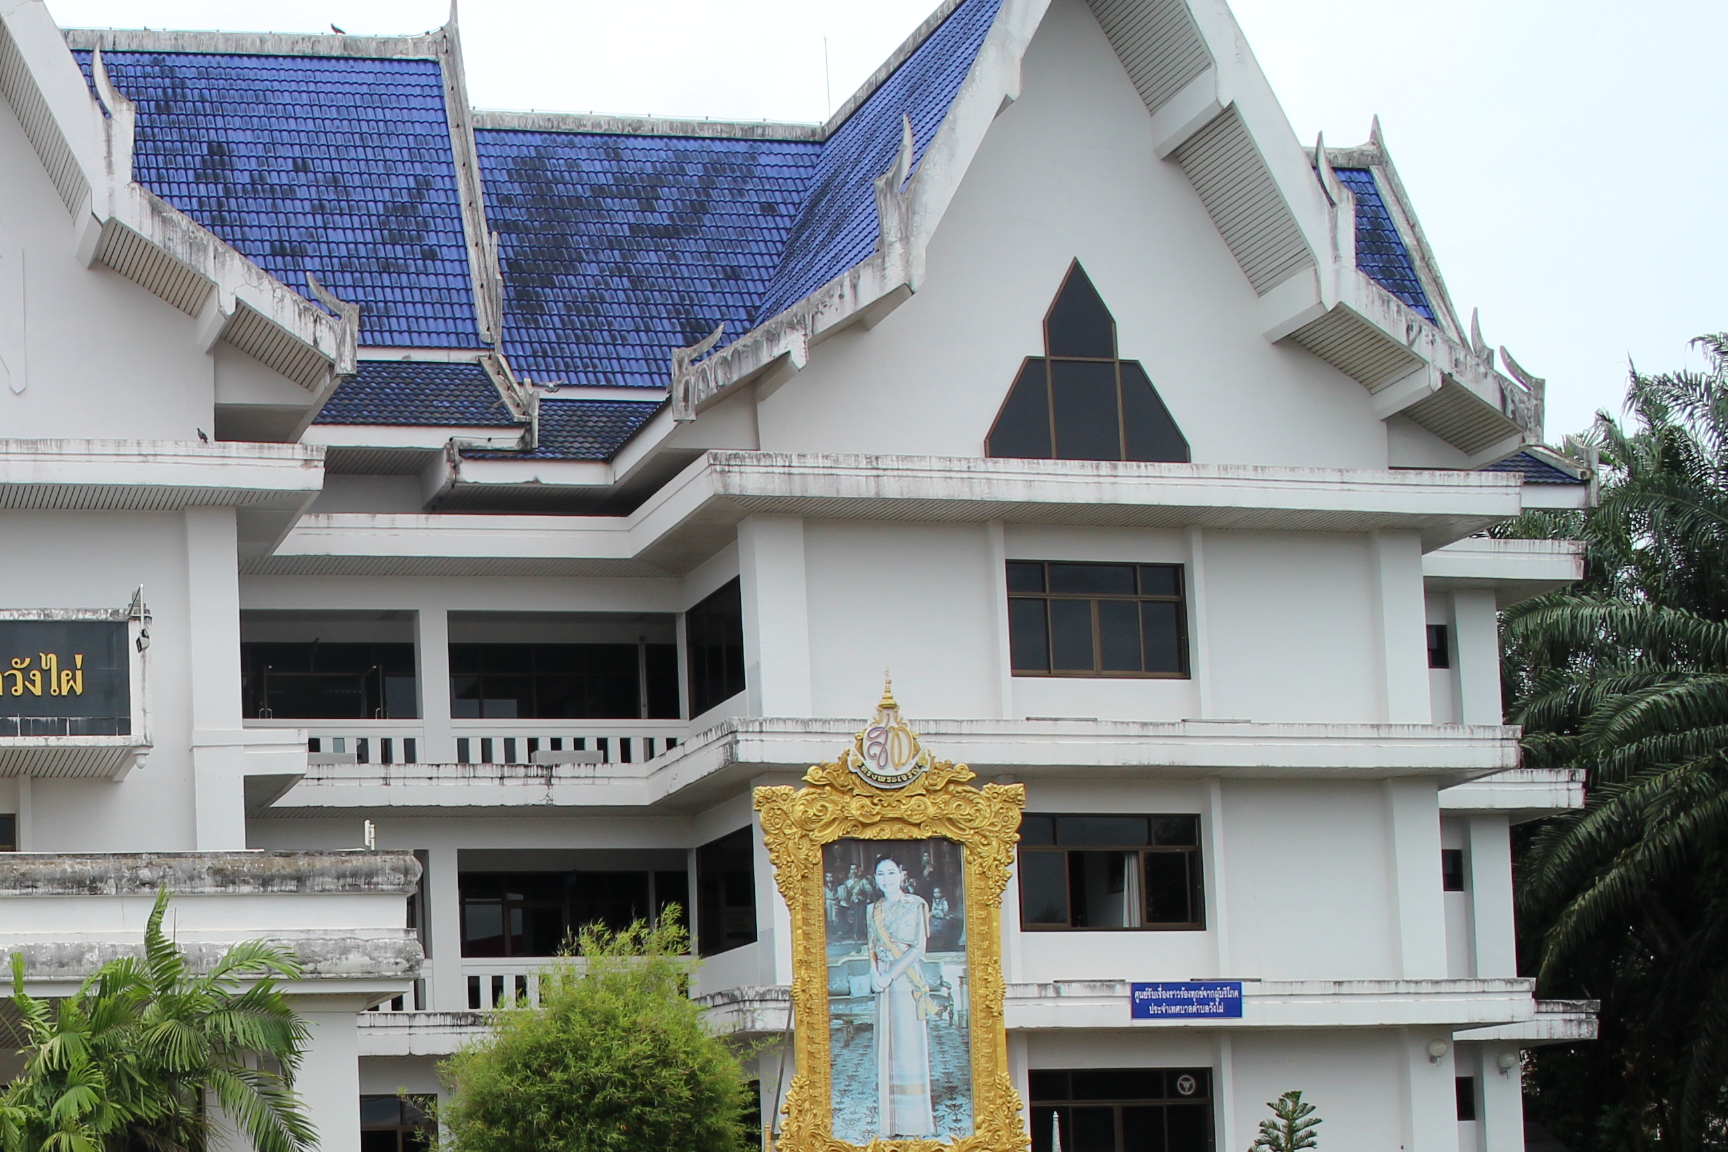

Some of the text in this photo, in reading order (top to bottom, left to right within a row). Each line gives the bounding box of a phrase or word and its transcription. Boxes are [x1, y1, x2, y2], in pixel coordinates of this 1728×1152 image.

[1149, 1001, 1224, 1014] ประจำเทศบาลตำบลวังไผ่
